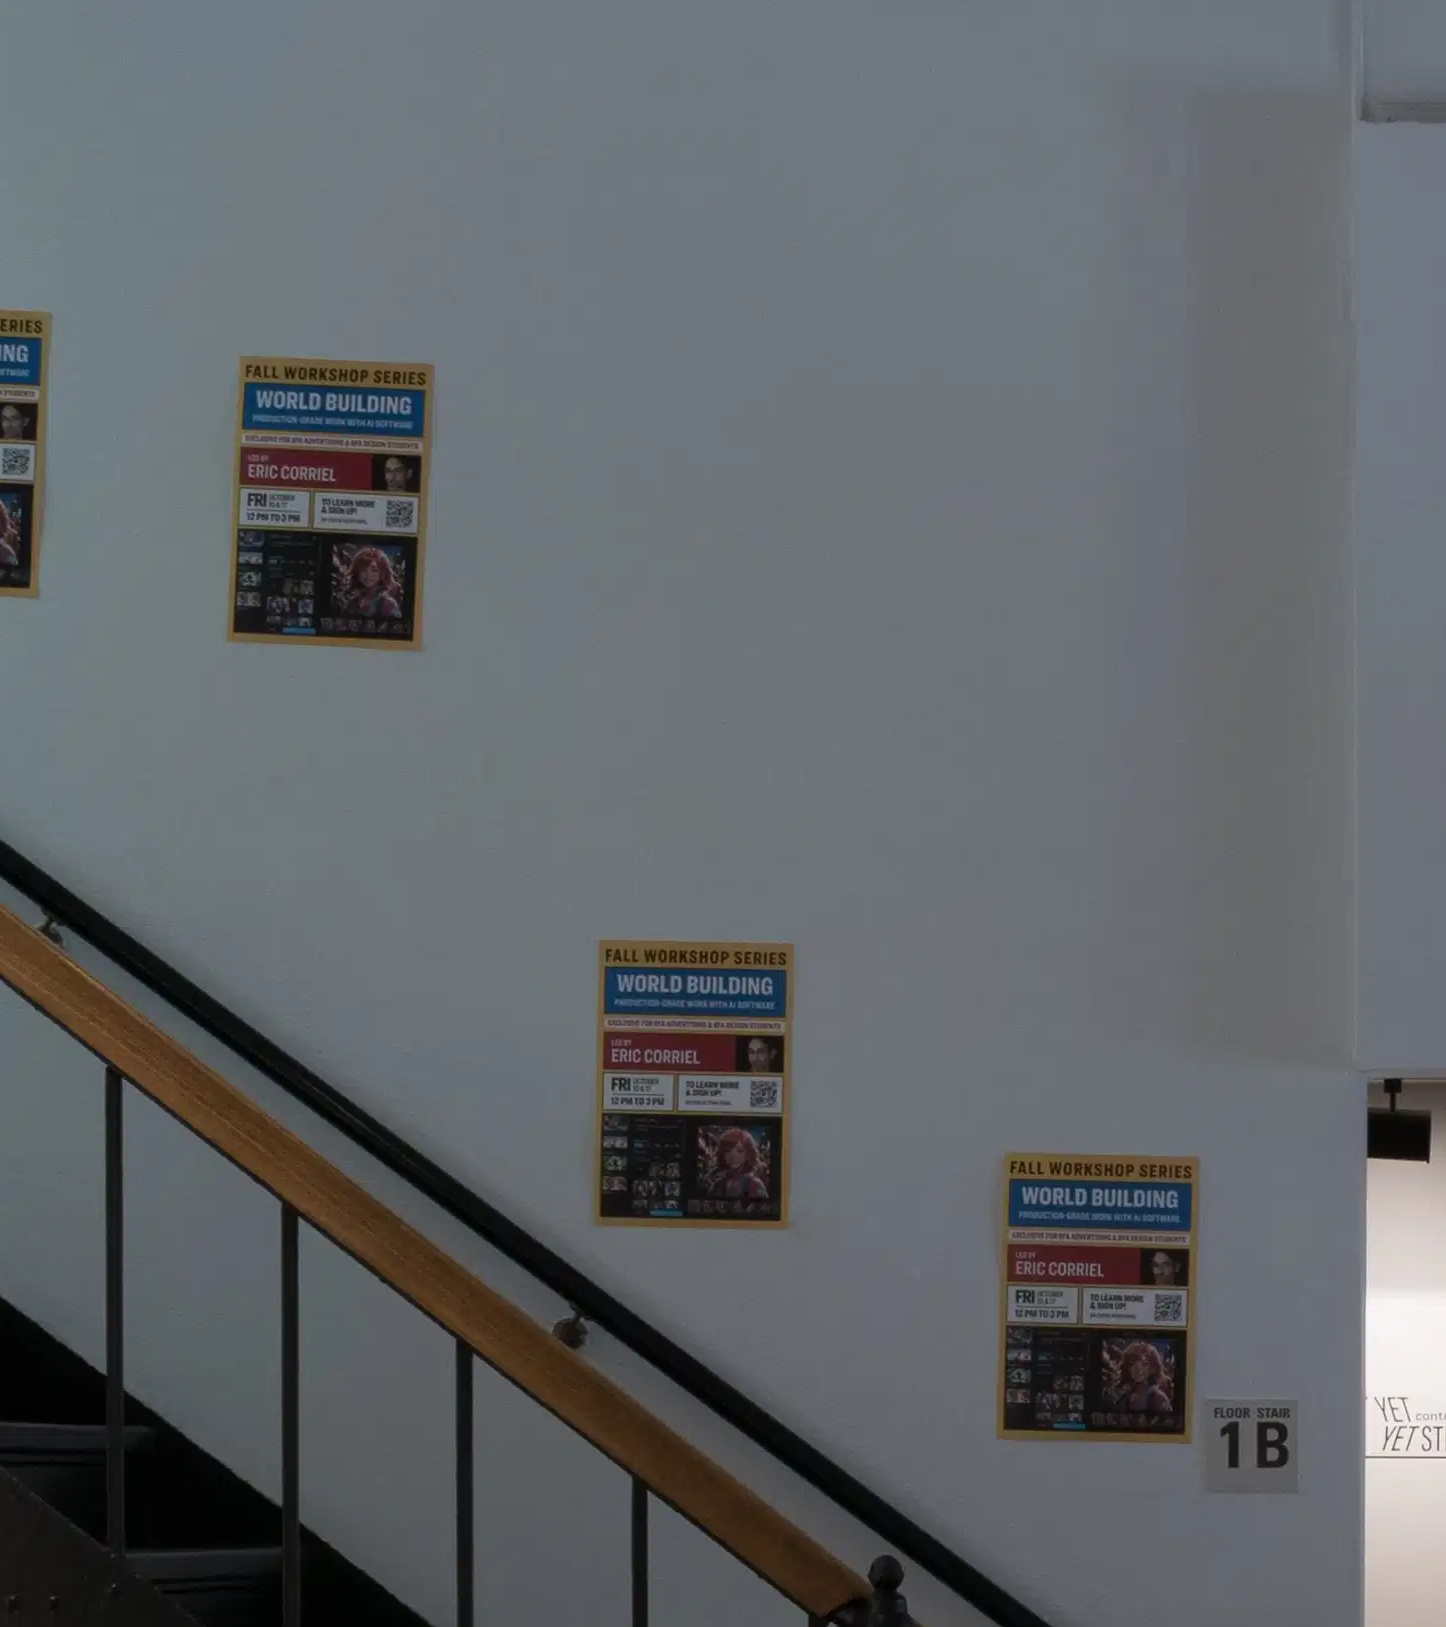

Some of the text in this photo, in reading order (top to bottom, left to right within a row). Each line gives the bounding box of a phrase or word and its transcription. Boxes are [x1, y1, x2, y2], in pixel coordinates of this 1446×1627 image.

[245, 364, 426, 385] FALL WORKSHOP SERIES
[255, 390, 412, 414] WORLD BUILDING
[248, 464, 336, 481] ERIC CORRIEL
[247, 492, 267, 507] FRI
[246, 512, 254, 520] 12
[270, 513, 280, 521] TO
[287, 514, 300, 522] PM
[605, 949, 786, 965] FALL WORKSHOP SERIES
[617, 974, 773, 994] WORLD BUILDING
[611, 1048, 700, 1064] ERIC CORRIEL
[611, 1077, 630, 1091] FRI
[634, 1097, 644, 1105] TO
[1010, 1161, 1191, 1178] FALL WORKSHOP SERIES
[1021, 1186, 1178, 1208] WORLD BUILDING
[1015, 1261, 1104, 1277] ERIC CORRIEL
[1015, 1289, 1035, 1303] FRI
[1056, 1310, 1068, 1318] PM
[1214, 1408, 1290, 1418] FLOOR STAIR
[1374, 1396, 1411, 1422] YET
[1220, 1421, 1289, 1468] 1 B
[1382, 1426, 1419, 1451] YET
